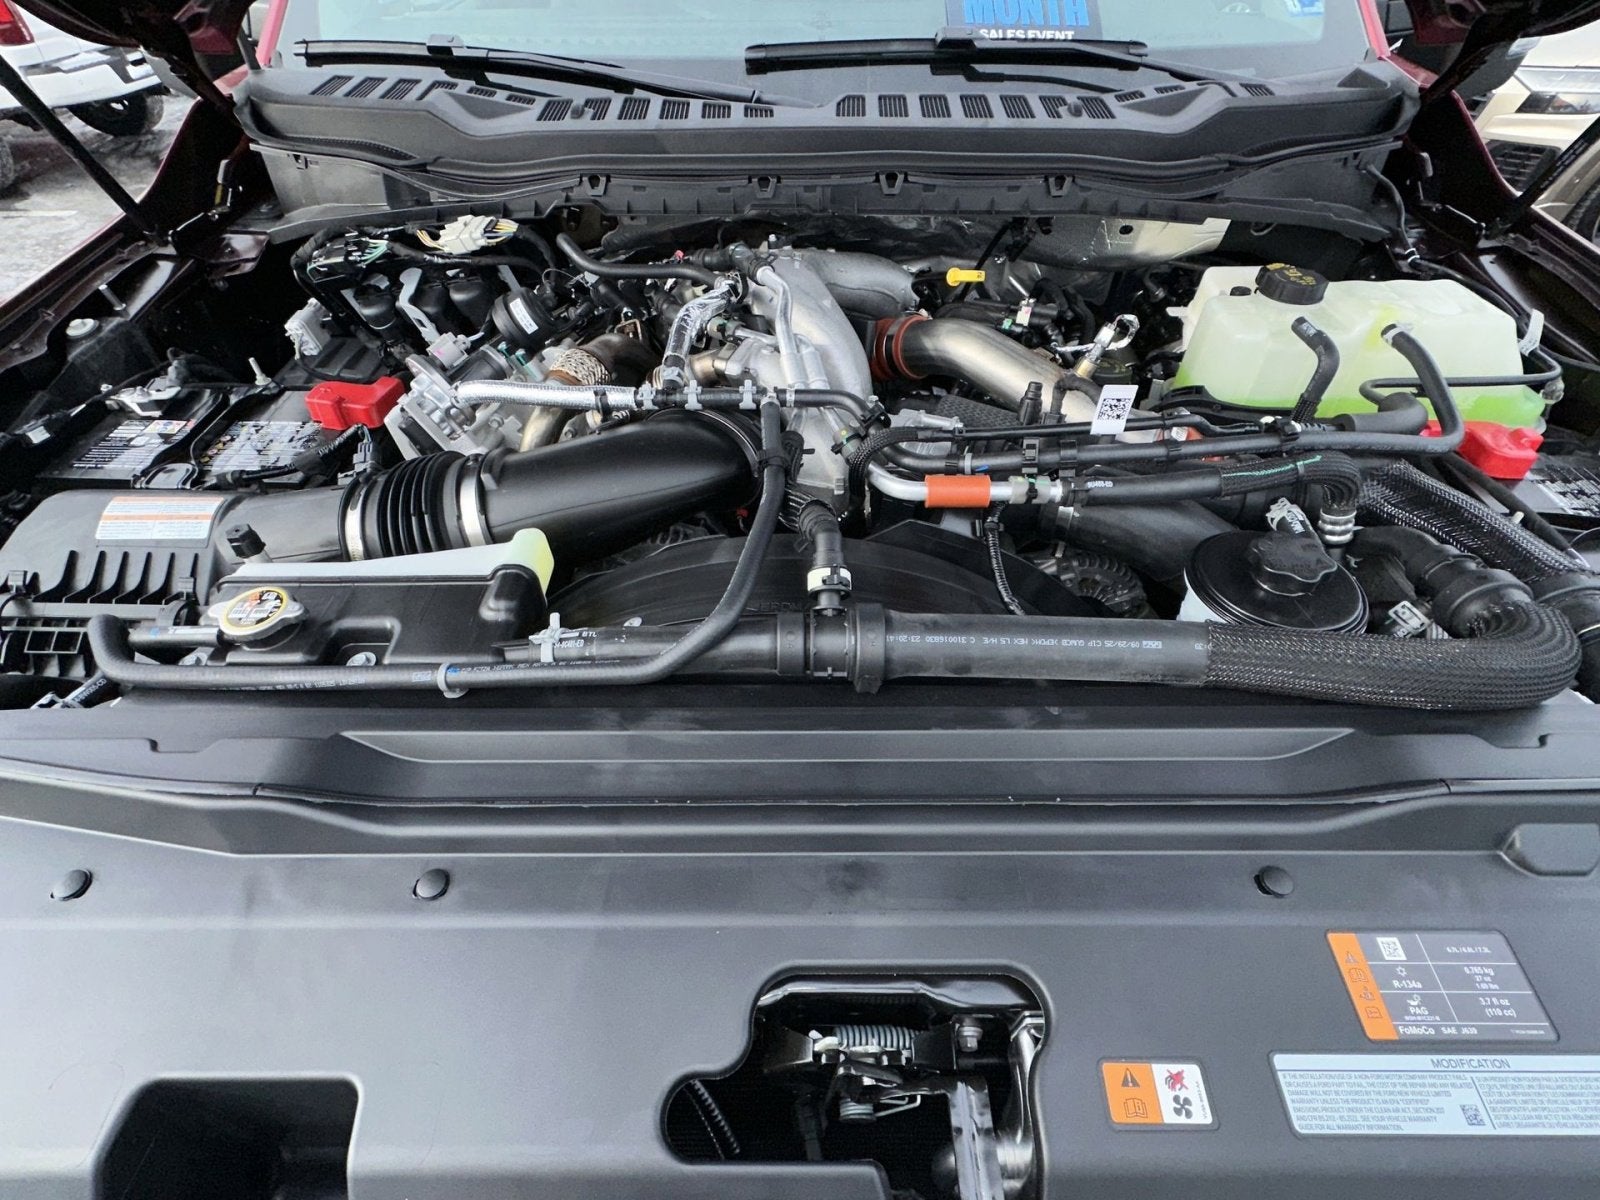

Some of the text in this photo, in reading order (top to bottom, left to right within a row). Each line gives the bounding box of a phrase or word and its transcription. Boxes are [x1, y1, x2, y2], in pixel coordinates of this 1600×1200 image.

[964, 0, 1090, 26] MONTH
[980, 28, 1075, 40] SALES EVENT
[1484, 967, 1495, 976] kg
[1392, 979, 1422, 989] R-134a
[1479, 997, 1491, 1006] 3.7
[1408, 1006, 1429, 1016] PAG
[1484, 1008, 1503, 1018] (110
[1398, 1025, 1478, 1035] FoMoCo SAE J639
[1430, 1058, 1511, 1069] MODIFICATION
